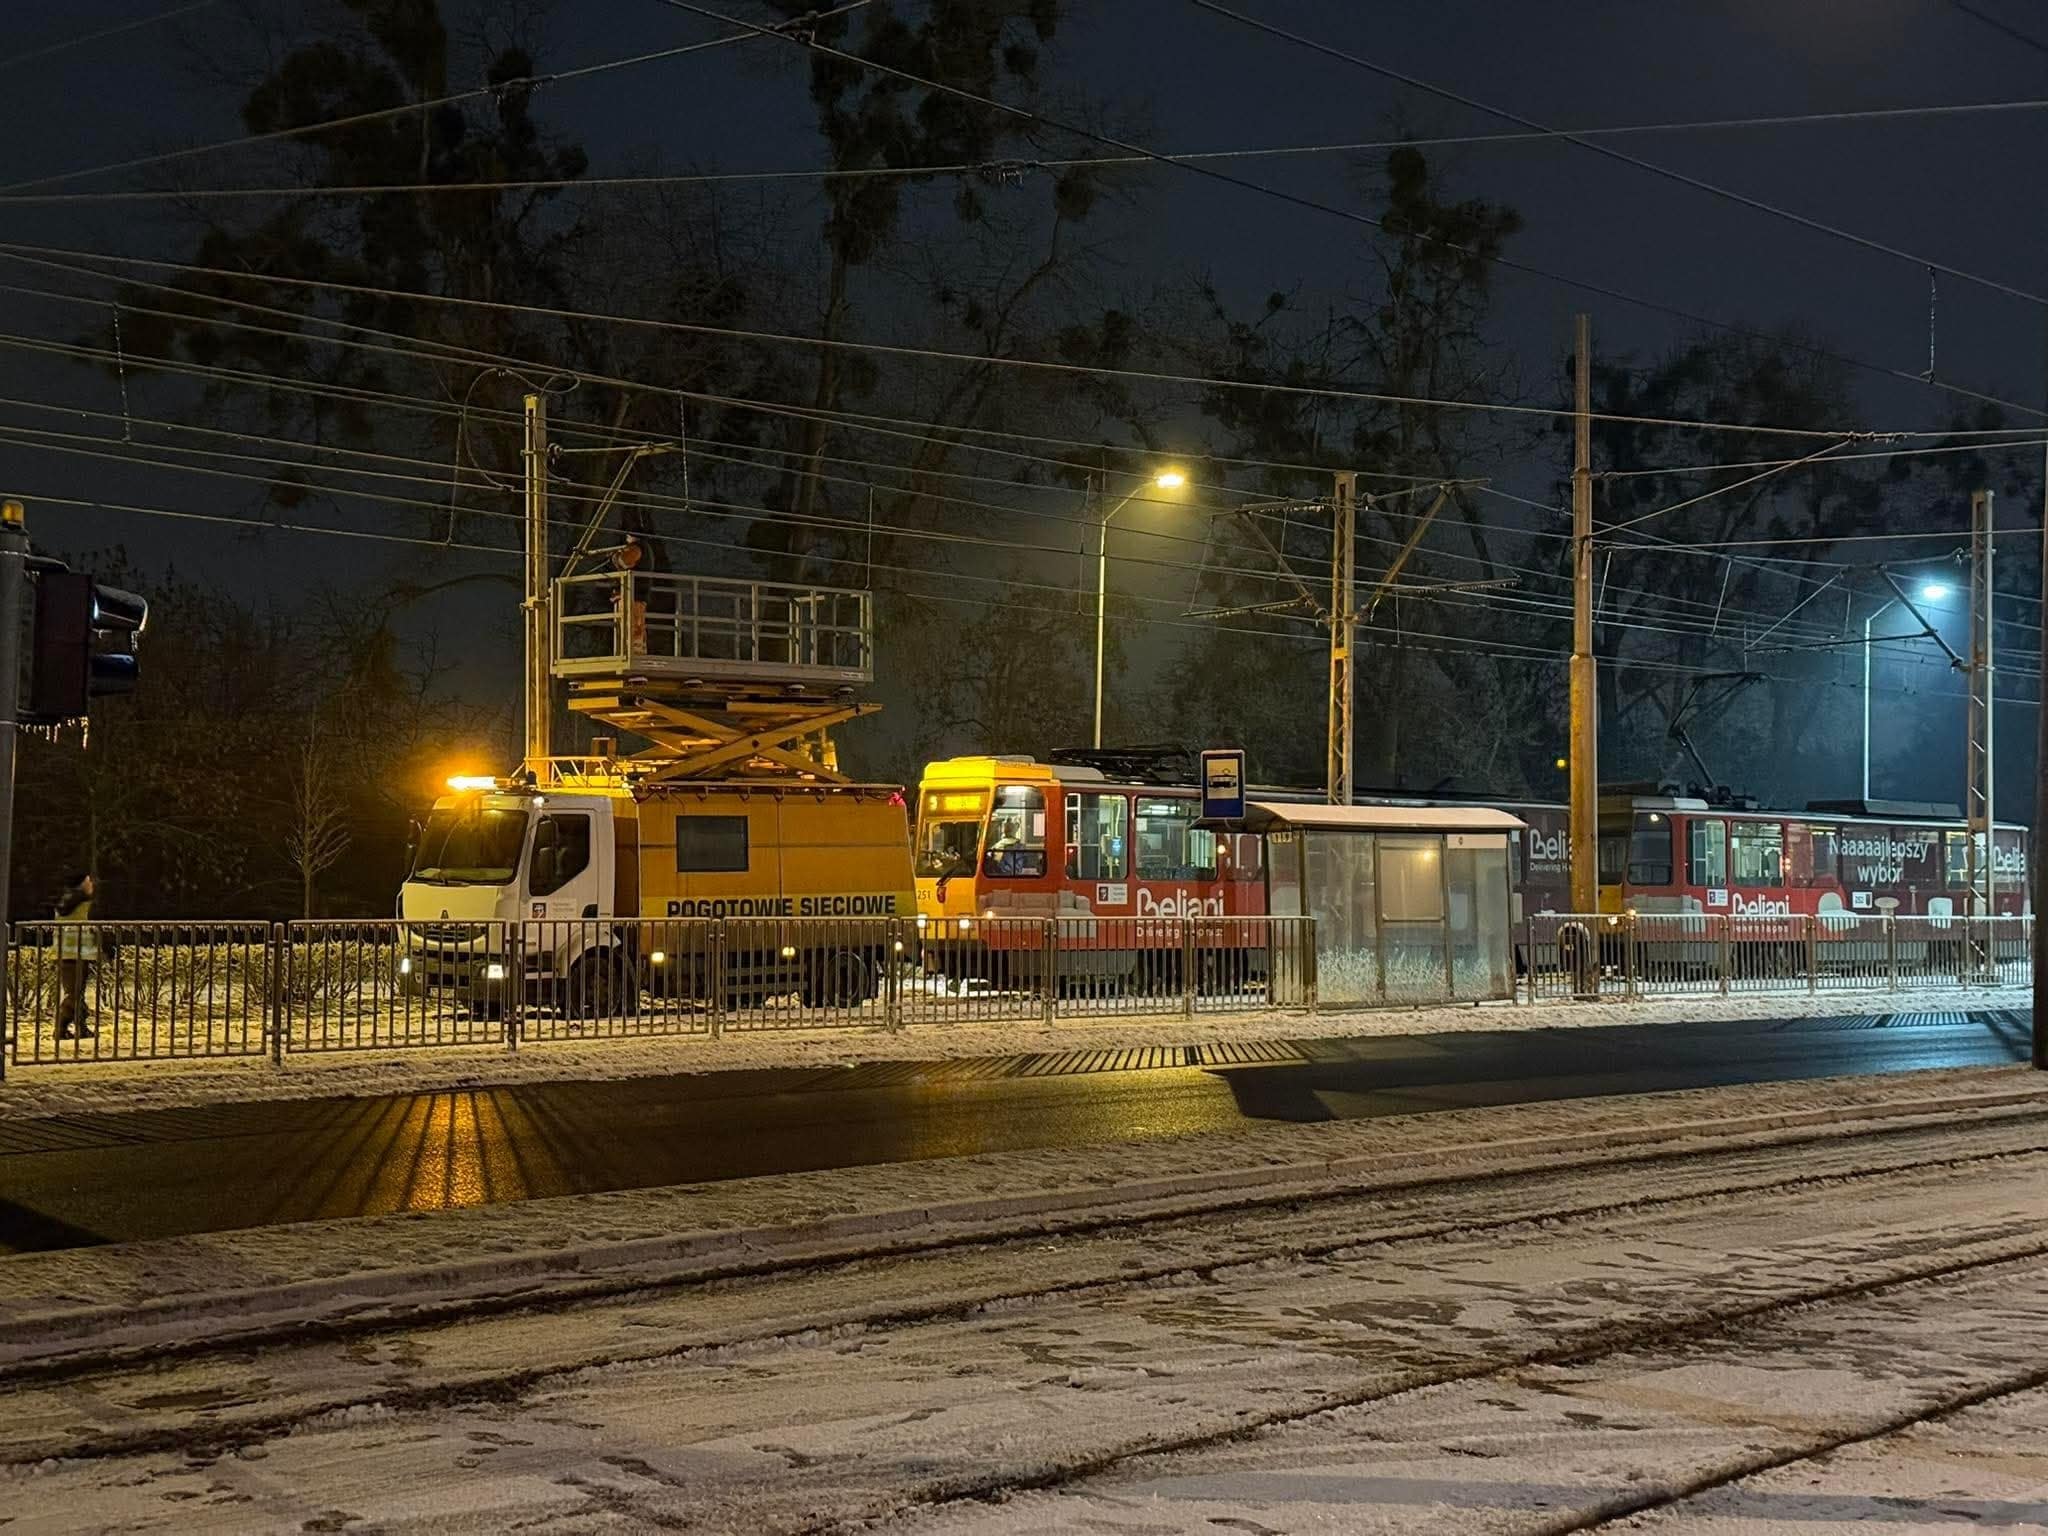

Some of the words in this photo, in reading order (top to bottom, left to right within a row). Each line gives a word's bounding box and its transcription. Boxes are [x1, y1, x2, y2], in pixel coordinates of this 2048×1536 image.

[1857, 862, 1903, 887] wybór
[667, 898, 794, 918] POGOTOWIE
[800, 895, 896, 916] SIECIOWE
[1137, 887, 1225, 924] Beliani
[1732, 892, 1789, 922] Beliani
